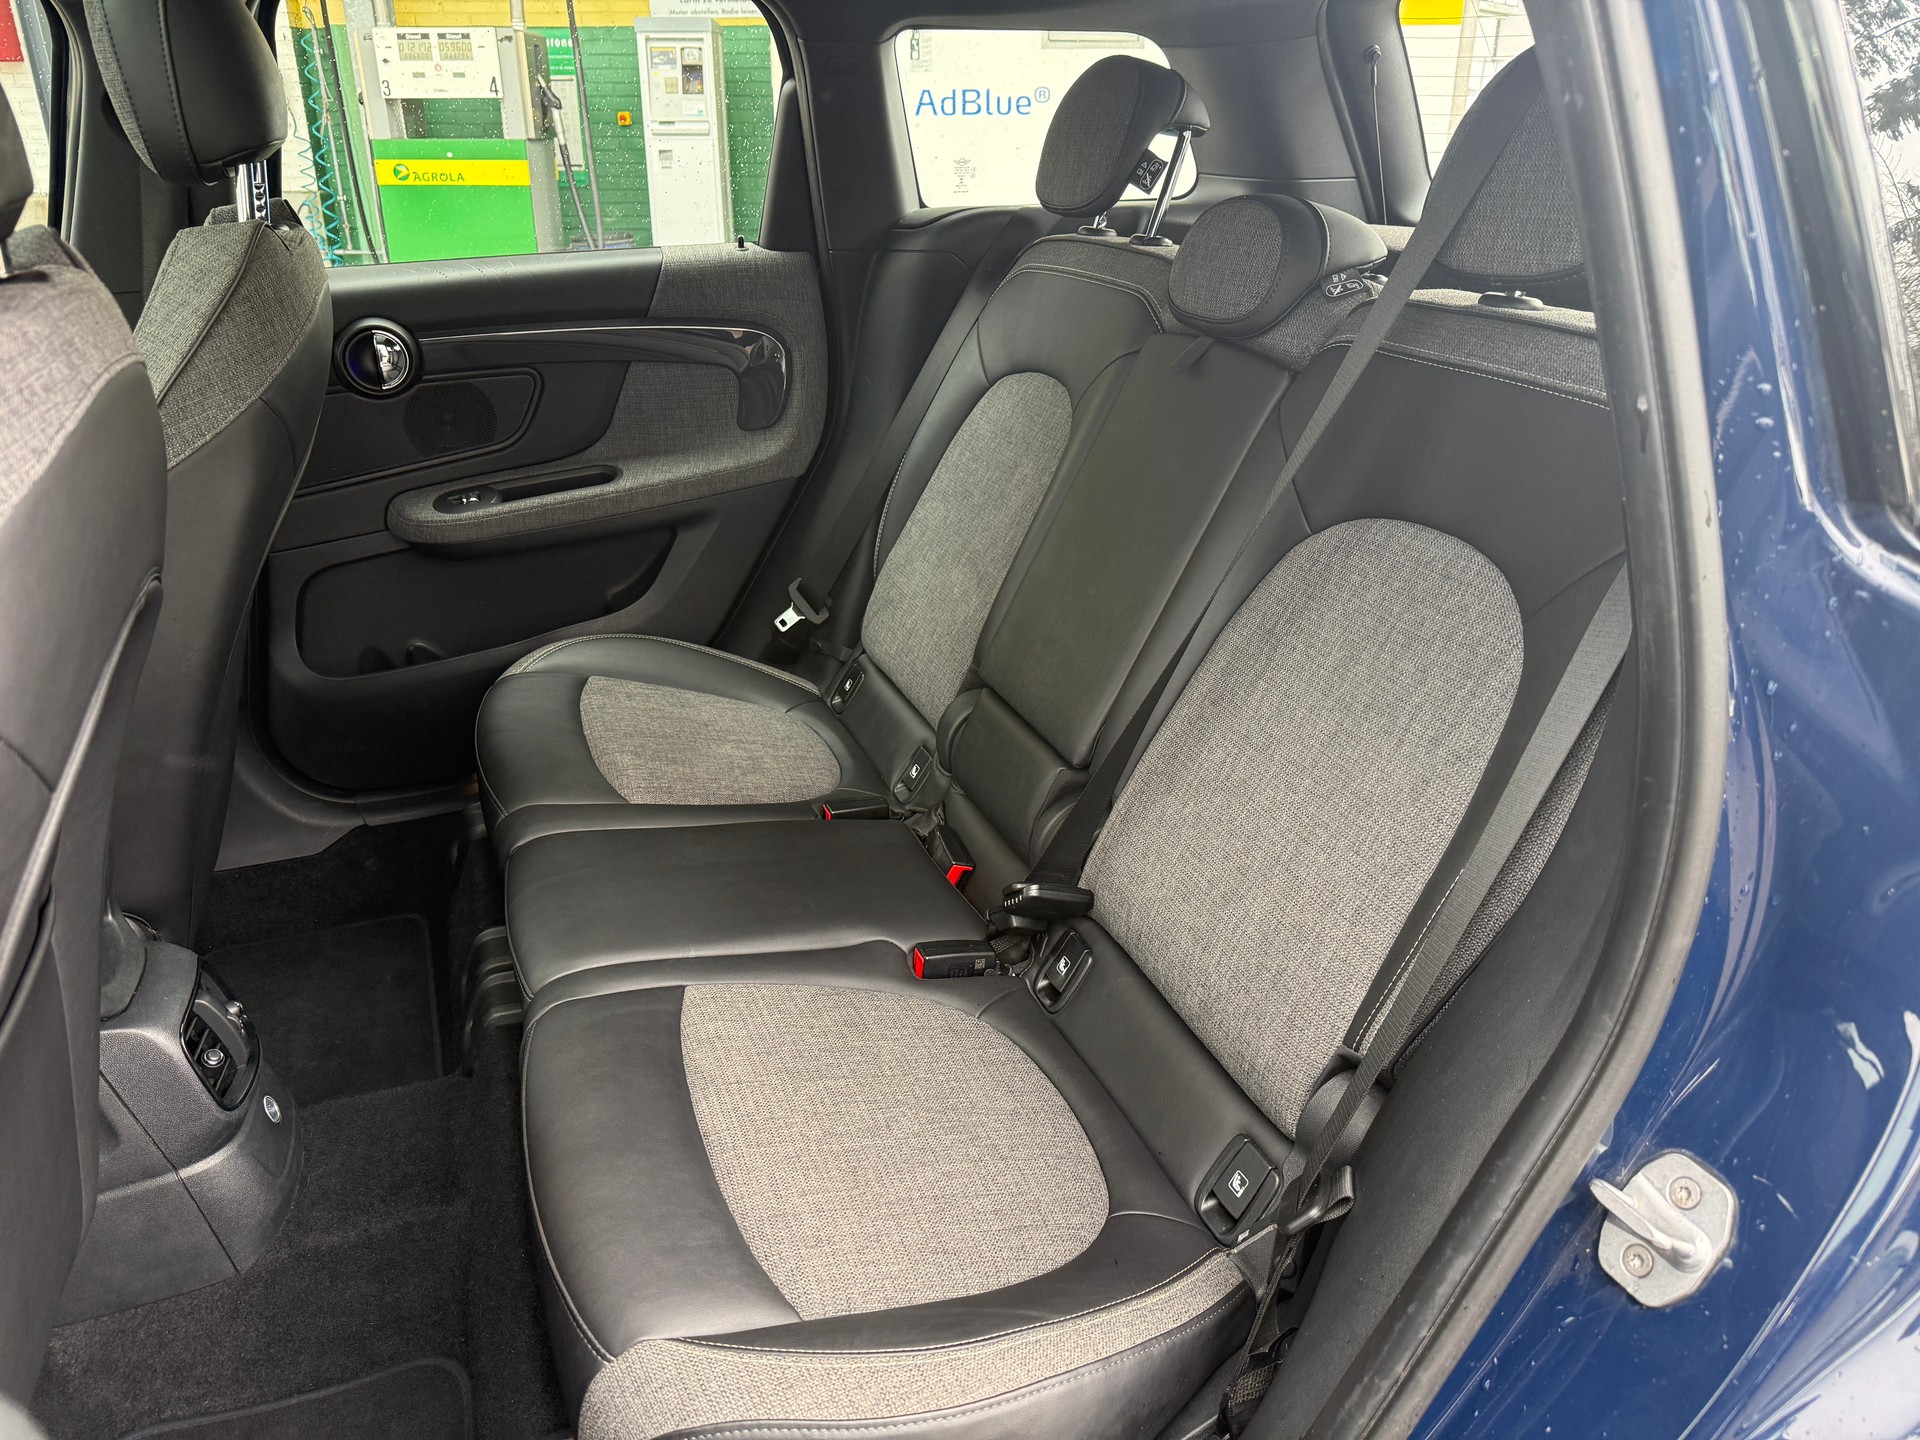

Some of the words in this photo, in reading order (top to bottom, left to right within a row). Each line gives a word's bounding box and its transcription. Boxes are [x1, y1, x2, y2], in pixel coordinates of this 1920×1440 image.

[381, 80, 391, 96] 3
[489, 76, 499, 96] 4
[413, 172, 465, 182] AGROLA
